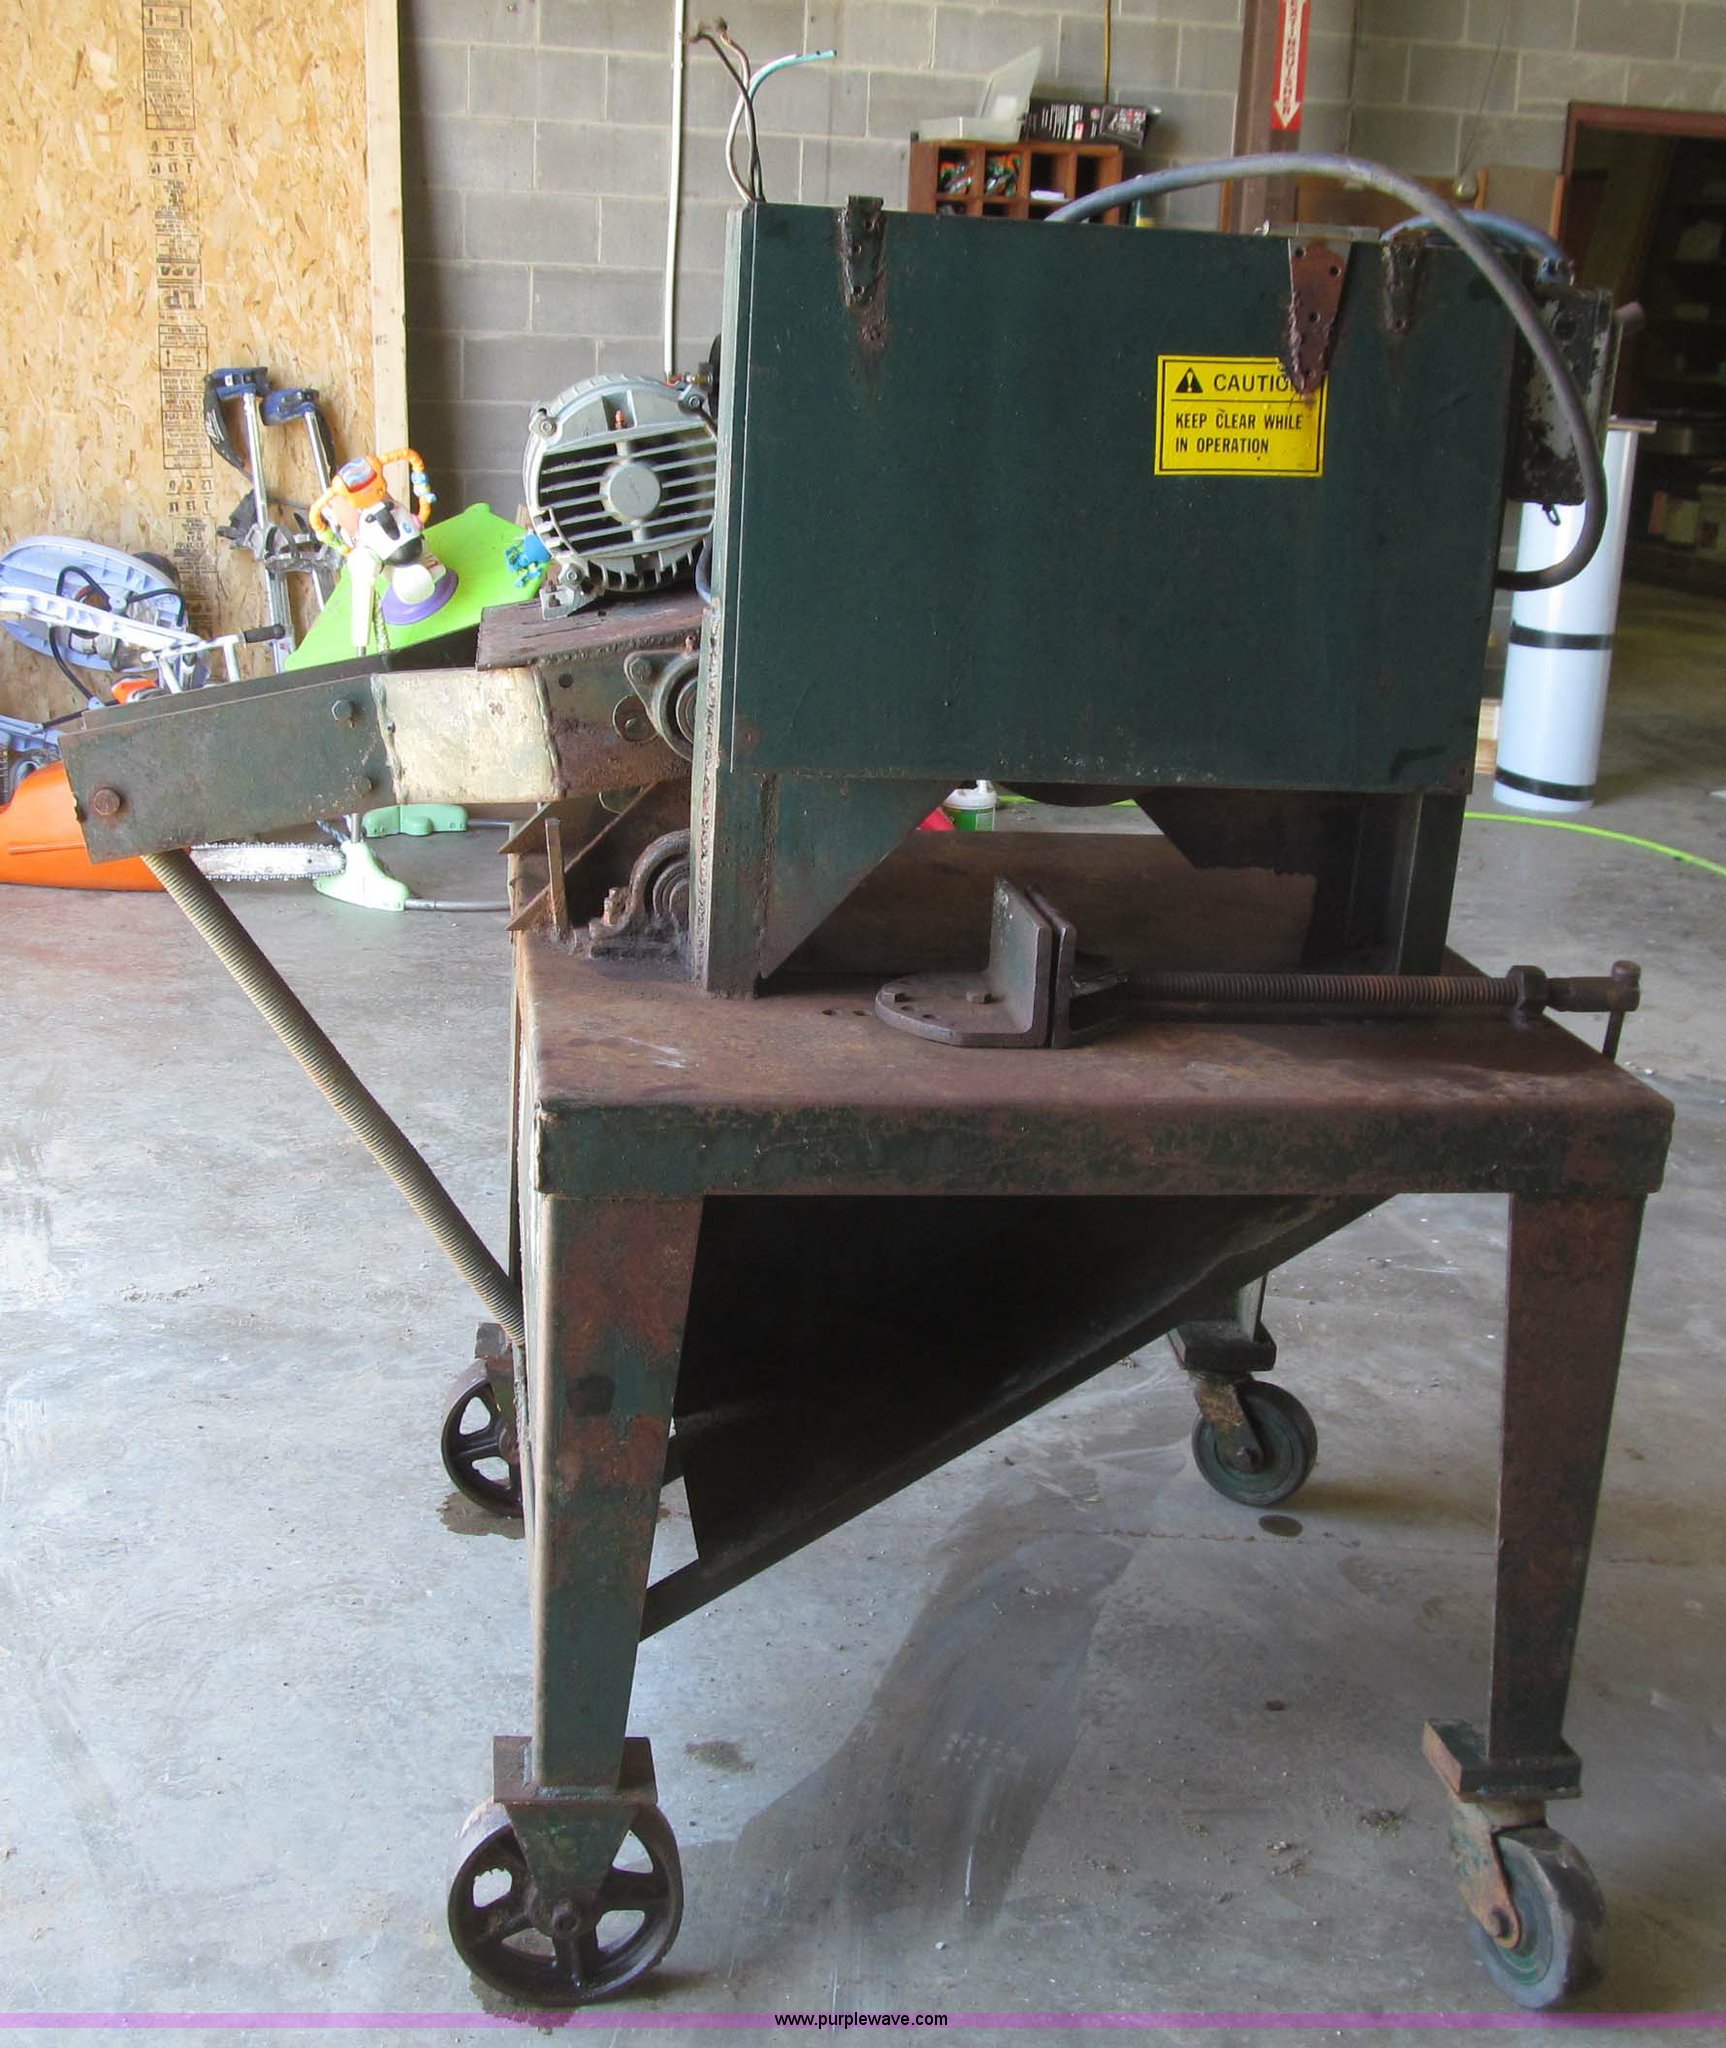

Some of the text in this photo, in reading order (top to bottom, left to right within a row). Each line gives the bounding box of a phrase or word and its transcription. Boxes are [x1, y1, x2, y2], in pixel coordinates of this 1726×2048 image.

[1213, 372, 1298, 393] CAUTIO
[1175, 412, 1303, 431] KEEP CLEAR WHILE
[1175, 437, 1269, 454] IN OPERATION
